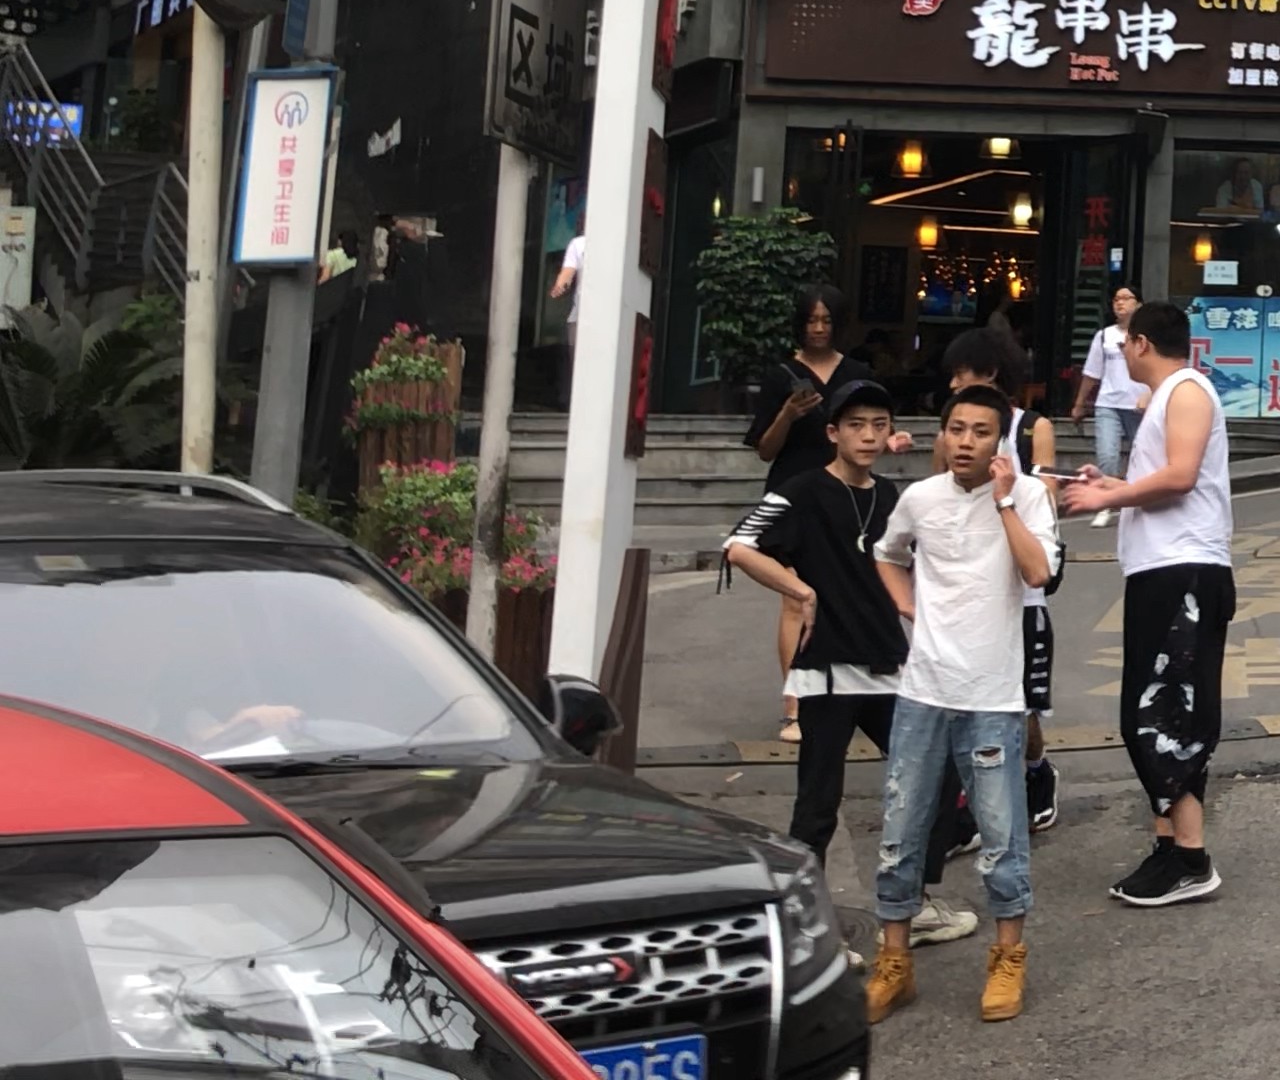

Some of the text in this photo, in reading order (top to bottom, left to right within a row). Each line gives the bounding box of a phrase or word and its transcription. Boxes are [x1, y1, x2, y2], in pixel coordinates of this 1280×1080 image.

[270, 135, 298, 246] 共享卫生间
[1205, 306, 1260, 331] 雪花
